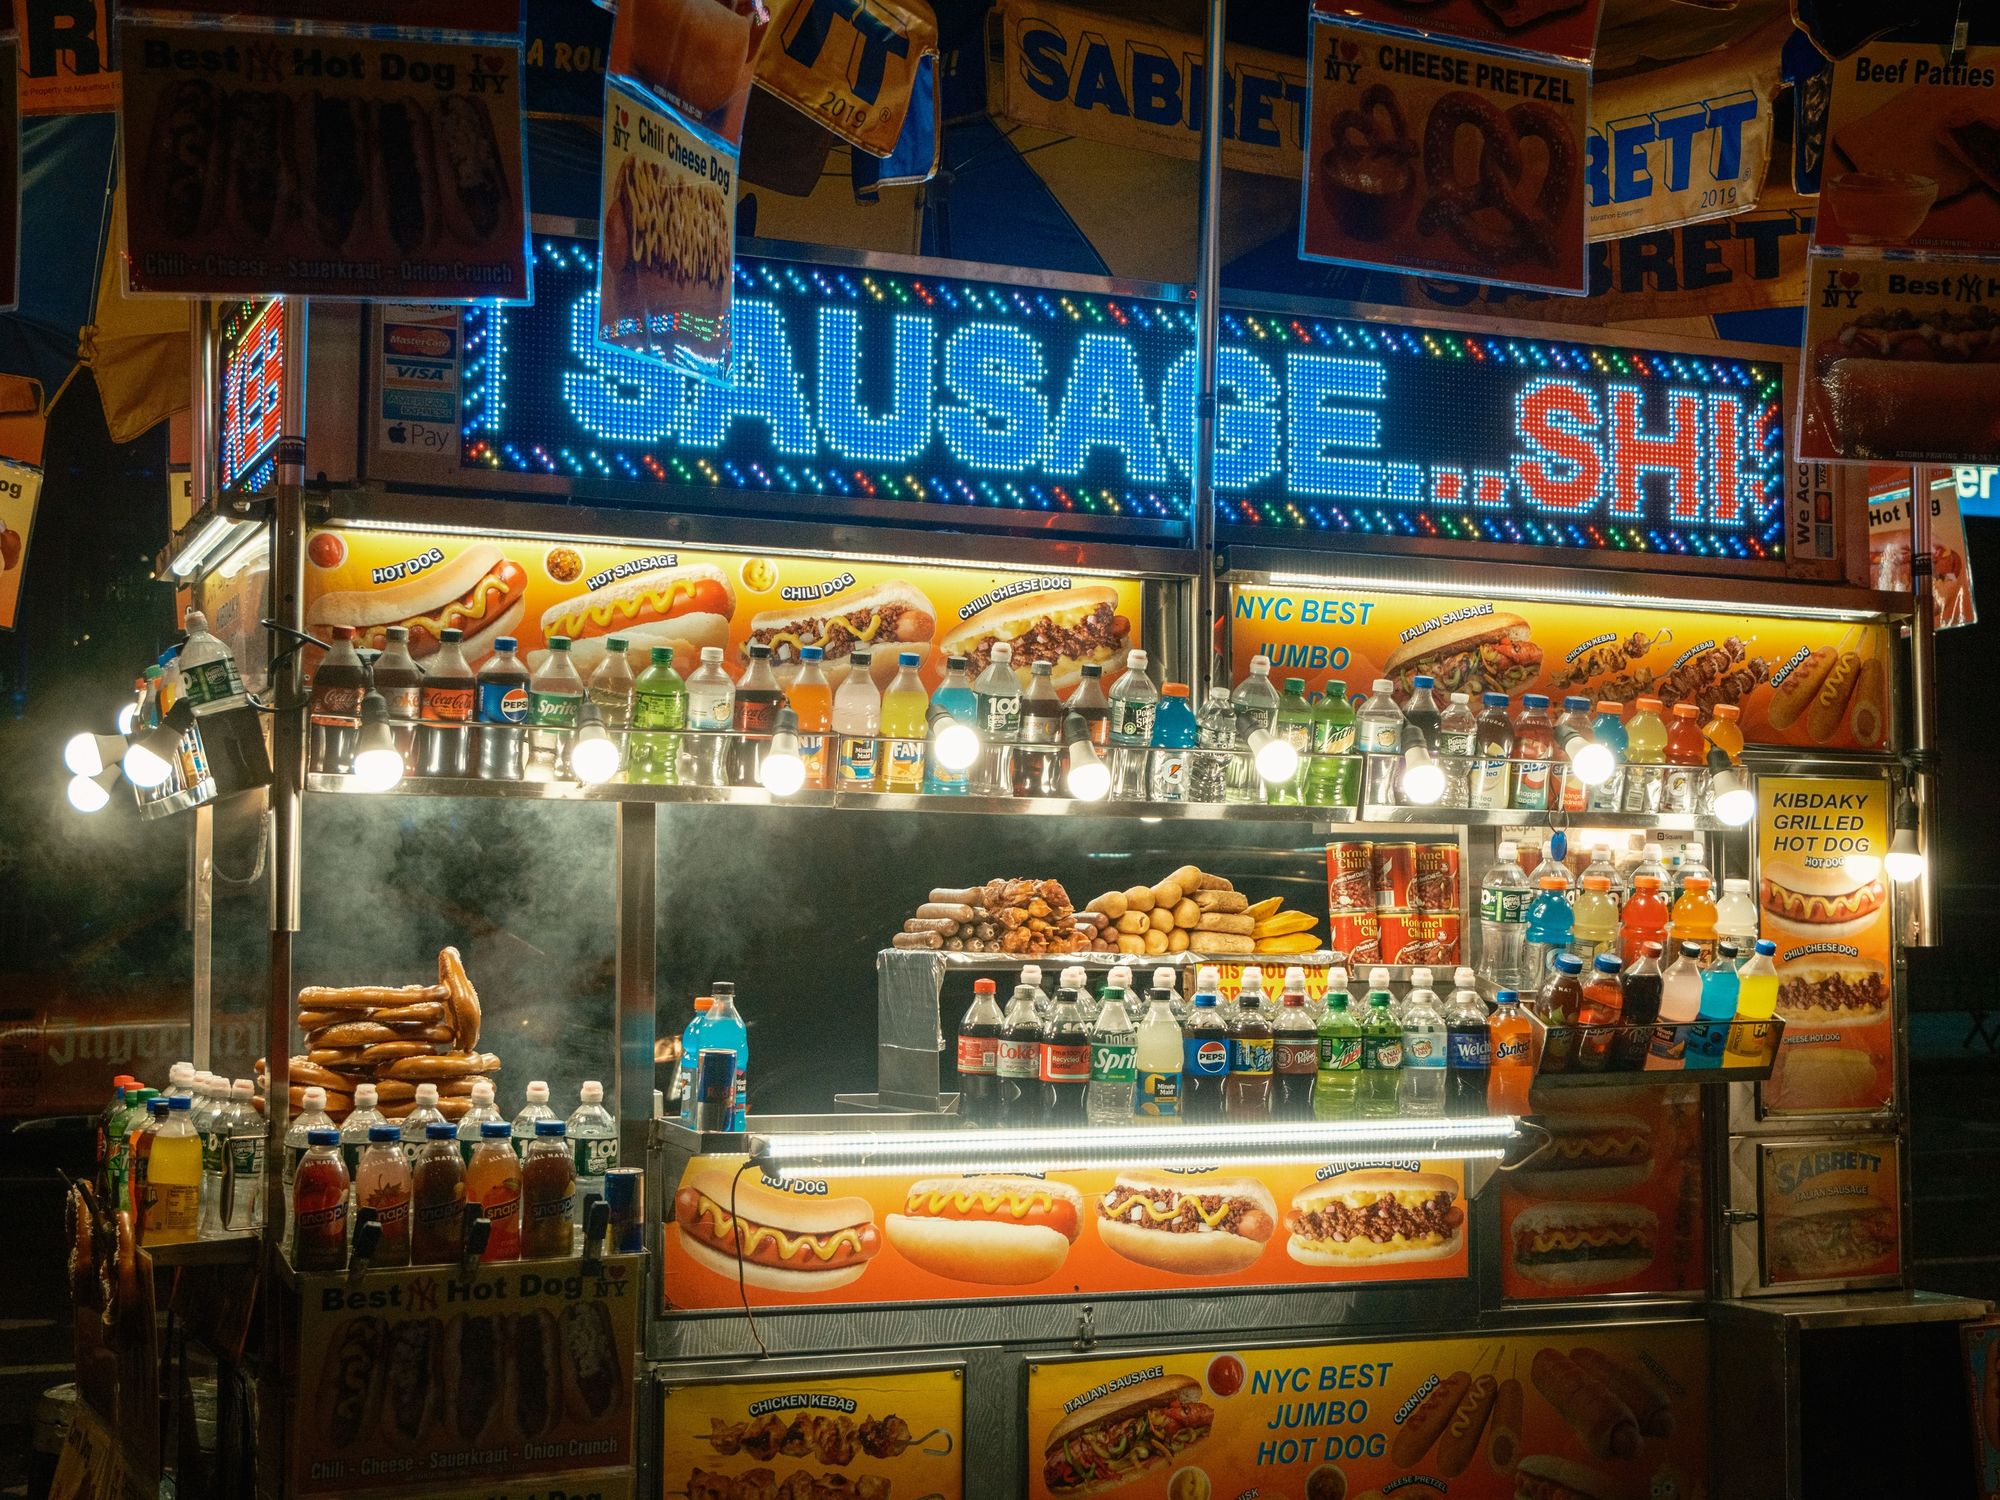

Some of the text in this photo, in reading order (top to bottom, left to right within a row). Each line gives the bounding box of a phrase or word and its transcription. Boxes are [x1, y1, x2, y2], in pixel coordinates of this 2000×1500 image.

[144, 40, 455, 91] Best Hot Dog
[1323, 60, 1361, 84] NY
[1379, 45, 1575, 104] CHEESE PRETZEL
[1855, 56, 1995, 88] Beef Patties
[468, 74, 508, 94] NY
[819, 91, 867, 129] 2019
[639, 115, 730, 195] Chili Cheese Dog
[1700, 187, 1736, 209] 2019
[144, 252, 185, 276] Chili
[204, 255, 266, 279] Cheese
[1889, 274, 1951, 297] Best
[1822, 290, 1863, 309] NY
[396, 366, 444, 381] VISA
[411, 424, 450, 452] Pay
[1956, 466, 2000, 499] er
[1797, 510, 1810, 545] We
[1869, 505, 1901, 527] Hot
[372, 549, 443, 584] HOT DOG
[587, 553, 678, 592] HOT SAUSAGE
[780, 573, 854, 601] CHILI DOG
[958, 576, 1072, 619] CHILI CHEESE DOG
[1235, 595, 1375, 626] NYC BEST
[1399, 602, 1493, 644] ITALIAN SAUSAGE
[1260, 643, 1351, 671] JUMBO
[1565, 633, 1617, 664] CHICKEN KEBAB
[1672, 640, 1715, 670] SHISH KEBAB
[1770, 645, 1811, 689] CORN DOG
[430, 692, 471, 709] Coca-Cola
[503, 700, 528, 710] PEPSI
[537, 699, 578, 716] Sprite
[1486, 770, 1498, 778] tea
[1771, 792, 1869, 811] KIBDAKY
[1773, 813, 1864, 832] GRILLED
[1332, 847, 1370, 860] Hormel
[1773, 835, 1870, 853] HOT DOG
[1337, 858, 1365, 869] Chili
[1806, 855, 1847, 869] HOT DOG
[1783, 942, 1859, 962] CHILI CHEESE DOG
[1782, 1031, 1841, 1044] CHEESE HOT DOG
[1000, 1042, 1036, 1060] Coke
[1052, 1056, 1079, 1065] Recycled
[1199, 1053, 1225, 1061] PEPSI
[1386, 1056, 1400, 1066] DRY
[1159, 1089, 1174, 1097] Maid
[1315, 1161, 1347, 1181] CHILI
[1393, 1159, 1420, 1172] DOG
[1776, 1150, 1882, 1197] SABRETT
[760, 1171, 828, 1196] HOT DOG
[1827, 1184, 1869, 1197] SAUSAGE
[321, 1284, 401, 1312] Best
[446, 1277, 507, 1302] Hot
[521, 1273, 584, 1299] Dog
[594, 1280, 629, 1297] NY
[1062, 1365, 1164, 1414] ITALIAN SAUSAGE
[1250, 1361, 1394, 1396] NYC BEST
[749, 1394, 856, 1416] CHICKEN KEBAB
[1392, 1373, 1441, 1425] CORN DOG
[1267, 1399, 1368, 1431] JUMBO
[311, 1437, 617, 1479] Chili Cheese Sauerkraut Onion Crunch
[1256, 1433, 1386, 1466] HOT DOG
[1382, 1474, 1449, 1496] CHEESE PRETZEL
